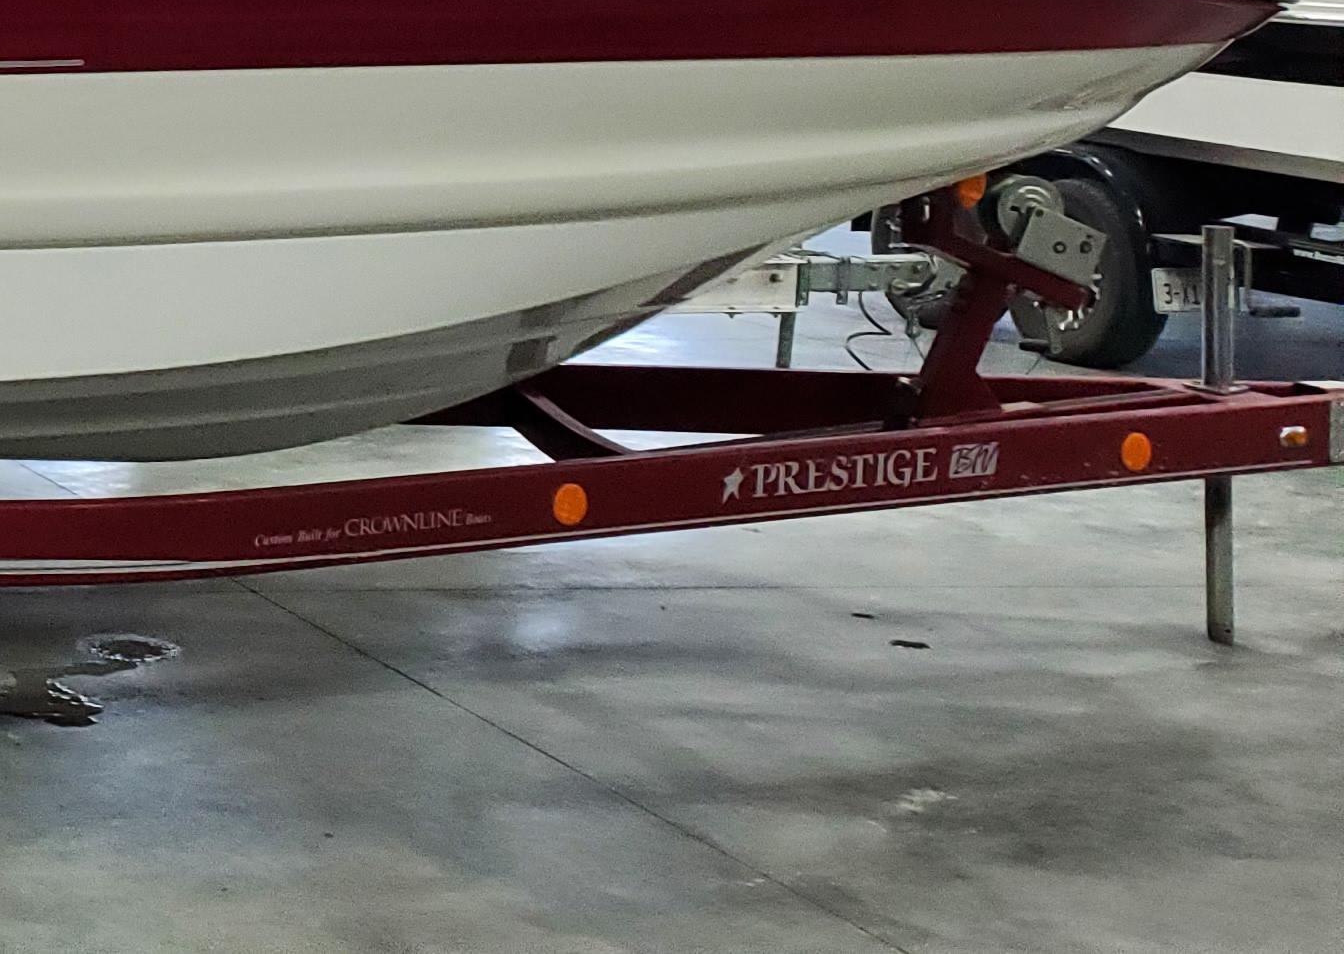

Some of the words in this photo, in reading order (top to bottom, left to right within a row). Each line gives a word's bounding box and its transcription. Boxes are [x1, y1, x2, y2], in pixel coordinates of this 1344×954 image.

[751, 447, 938, 497] PRESTIGE
[297, 528, 322, 542] Built
[324, 527, 341, 542] for
[344, 509, 463, 537] CROWNLINE
